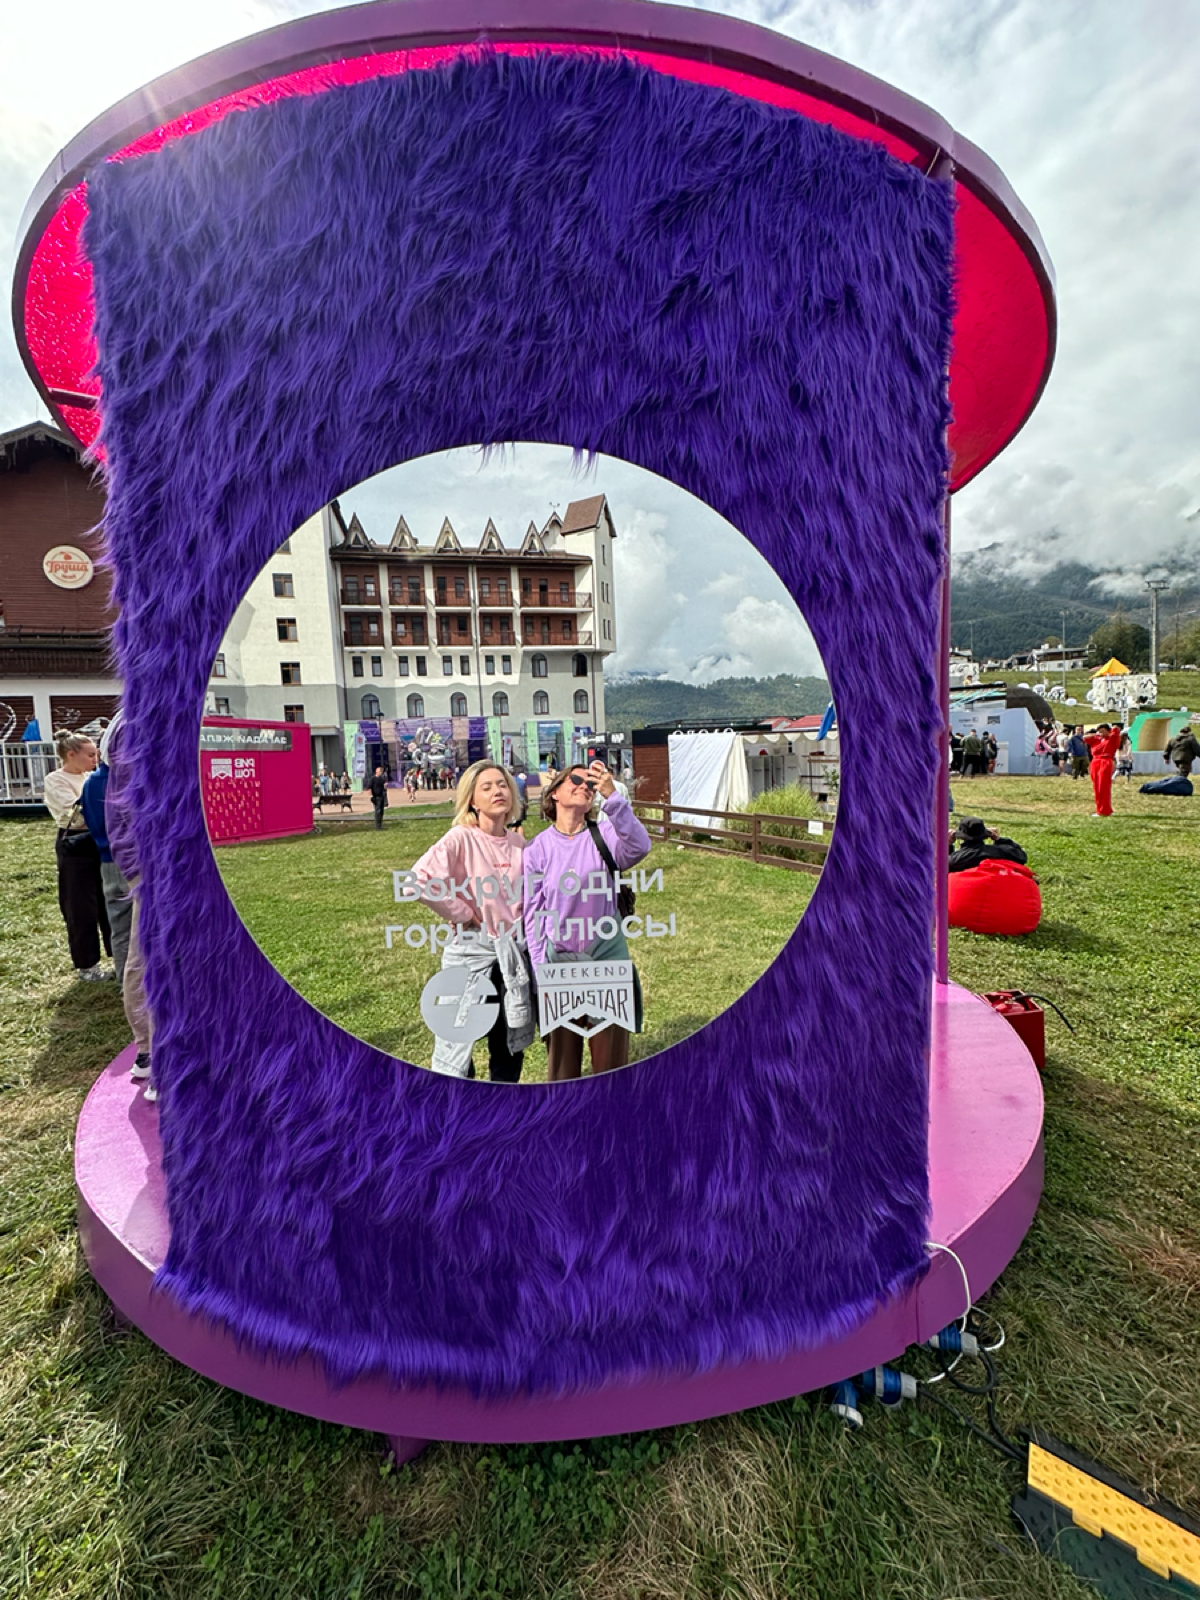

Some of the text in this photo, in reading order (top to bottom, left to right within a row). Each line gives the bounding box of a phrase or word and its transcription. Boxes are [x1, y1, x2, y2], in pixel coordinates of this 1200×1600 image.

[392, 868, 664, 907] Вокруг одни
[384, 910, 676, 954] горы и Плюсы
[543, 965, 627, 979] WEEKEND
